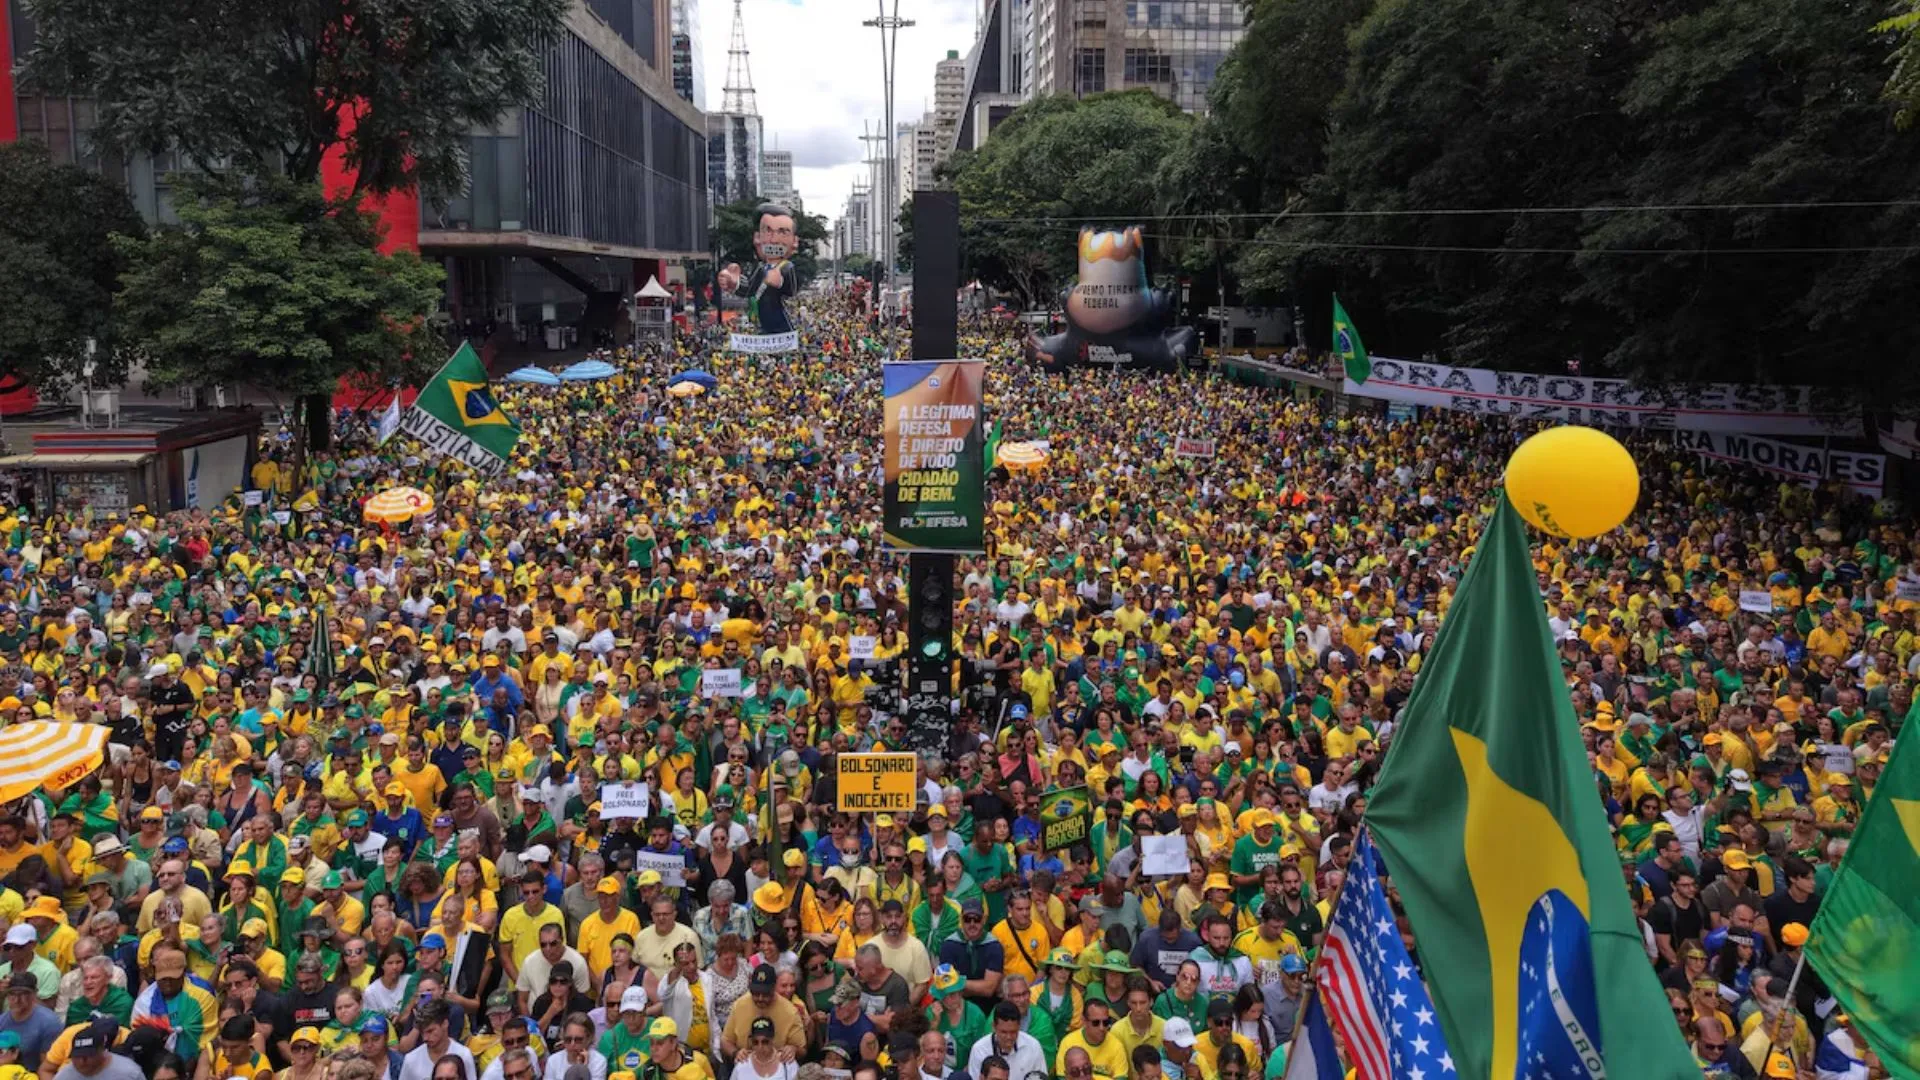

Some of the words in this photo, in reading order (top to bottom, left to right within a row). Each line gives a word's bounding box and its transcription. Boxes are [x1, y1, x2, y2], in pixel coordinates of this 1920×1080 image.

[1083, 297, 1119, 308] FEDERAL
[1371, 359, 1476, 393] ORA
[898, 405, 909, 420] A
[912, 402, 976, 420] LEGÍTIMA
[898, 421, 952, 436] DEFESA
[912, 438, 965, 453] DIREITO
[898, 454, 919, 469] DE
[921, 453, 957, 469] TODO
[1677, 429, 1716, 453] RA
[1726, 435, 1881, 483] MORAES
[898, 468, 960, 486] CIDADÃO
[898, 487, 919, 502] DE
[920, 486, 956, 502] BEM.
[704, 682, 740, 690] BOLSONARO
[841, 758, 913, 773] BOLSONARO
[616, 790, 635, 799] FREE
[603, 799, 647, 809] BOLSONARO
[1046, 815, 1085, 837] ACORDA
[638, 859, 683, 869] BOLSONARO
